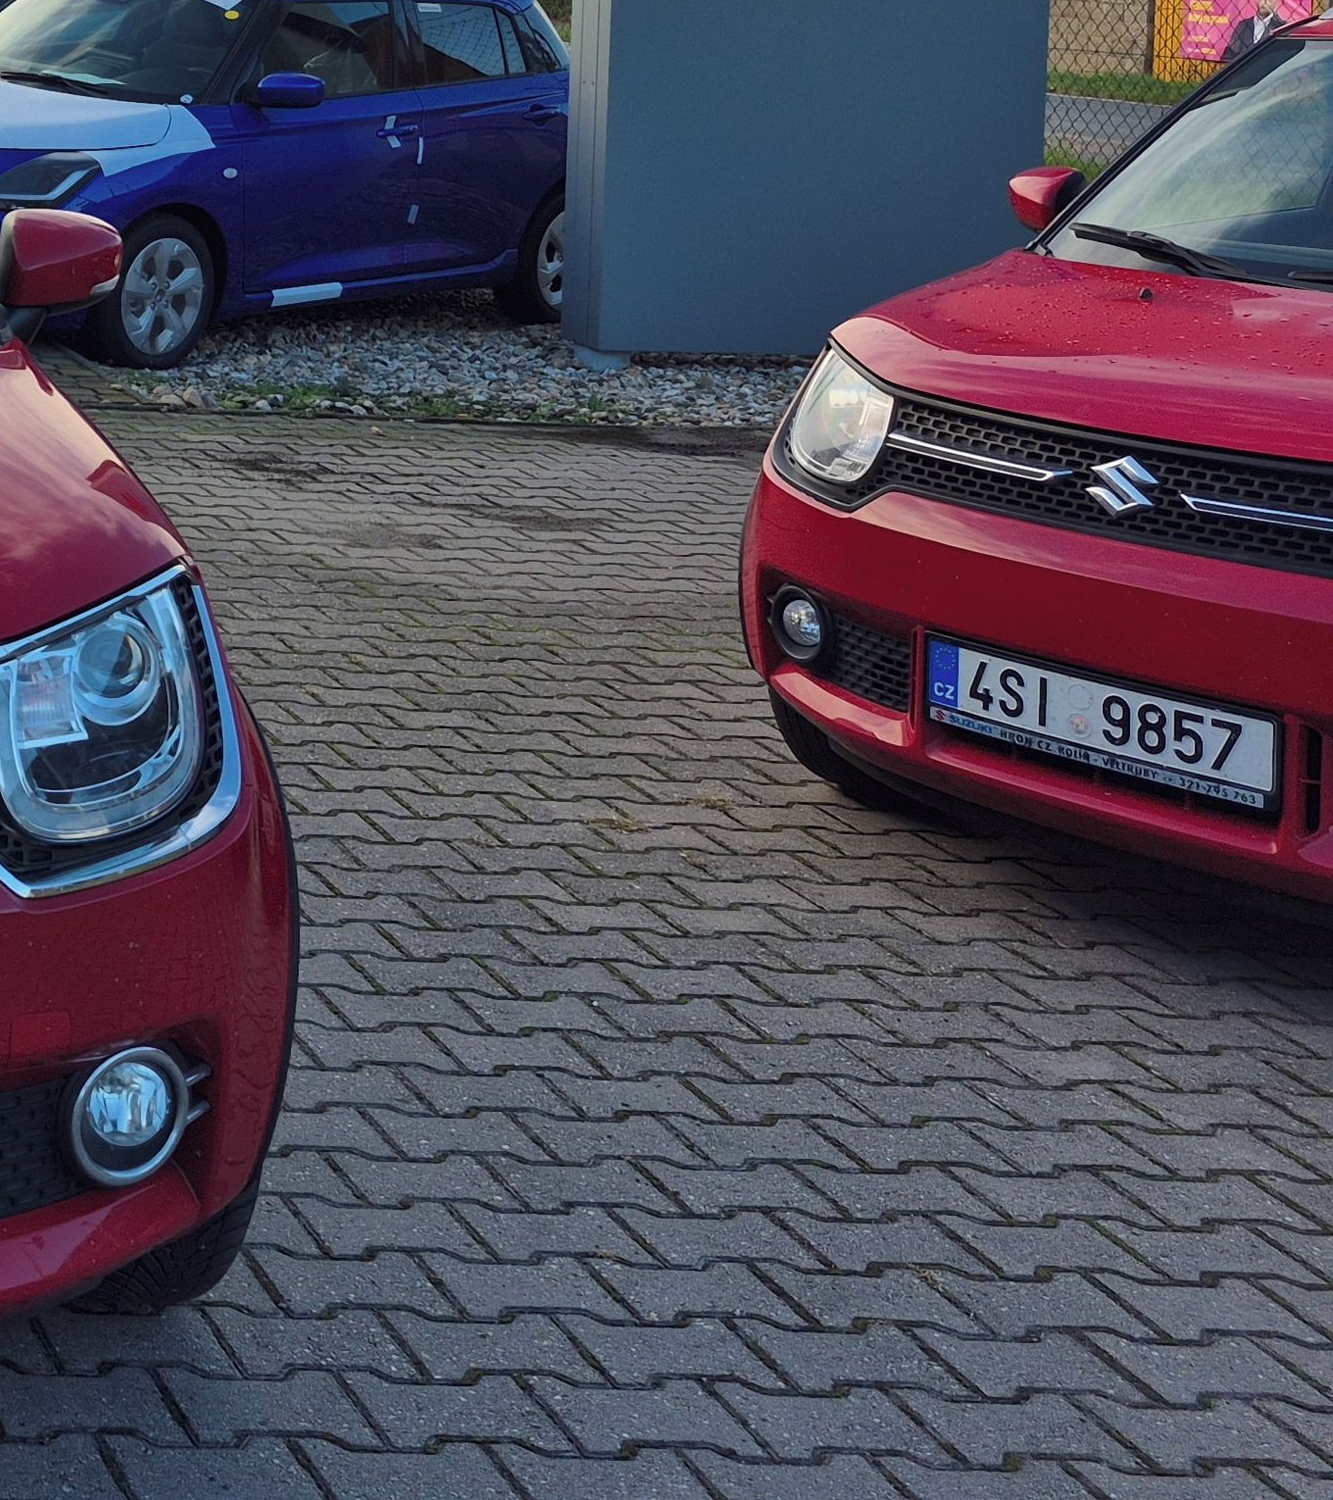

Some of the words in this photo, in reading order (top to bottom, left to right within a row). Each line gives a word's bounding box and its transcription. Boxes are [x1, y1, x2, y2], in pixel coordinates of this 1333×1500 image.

[934, 681, 955, 700] CZ
[969, 661, 1049, 727] 4SI
[1102, 695, 1243, 772] 9857
[949, 713, 993, 735] SUZUKI
[1000, 730, 1032, 748] HRON
[1037, 738, 1052, 751] CZ
[1101, 756, 1159, 779] VELTRUBY
[1234, 791, 1257, 805] 763
